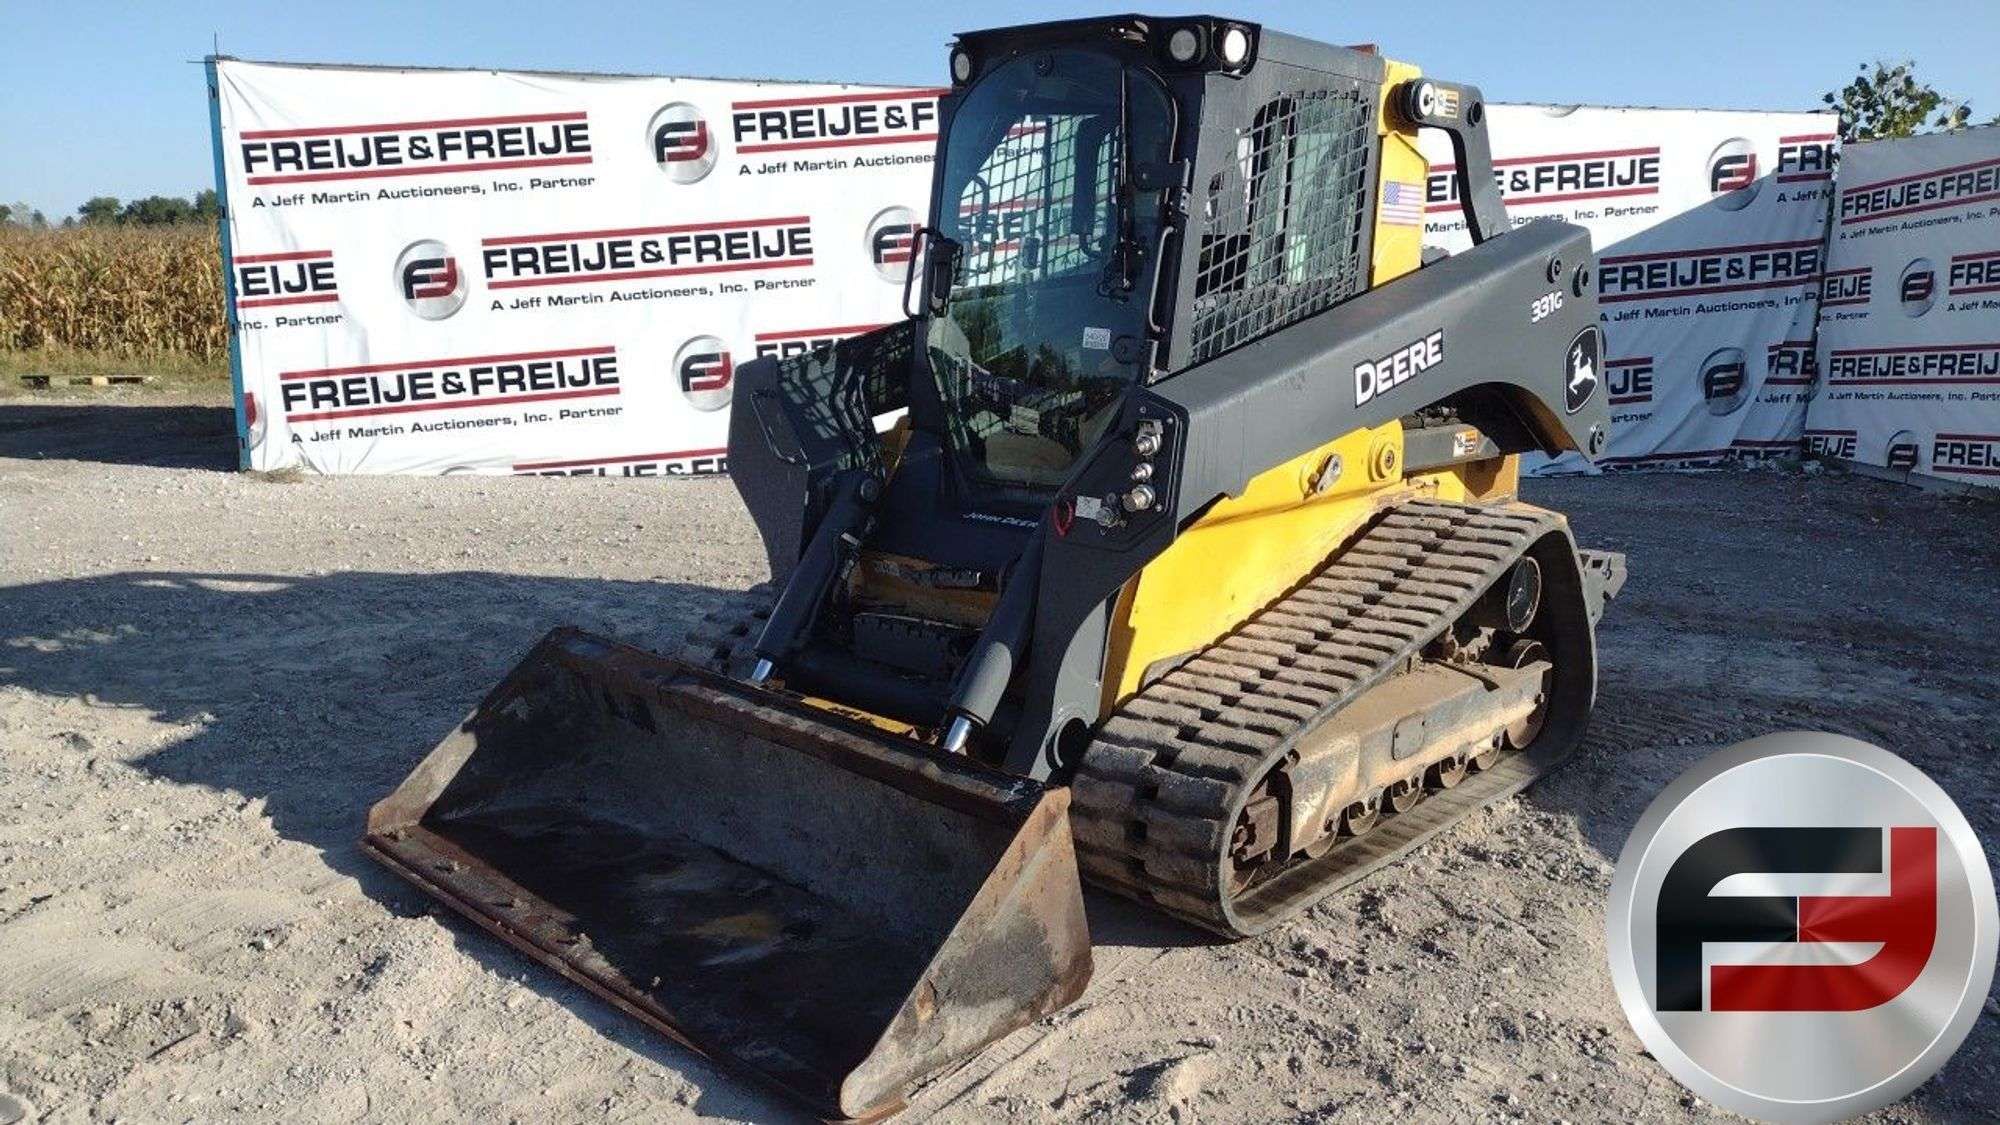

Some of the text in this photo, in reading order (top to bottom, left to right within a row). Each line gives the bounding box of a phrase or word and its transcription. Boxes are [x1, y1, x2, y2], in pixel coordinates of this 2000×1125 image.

[739, 165, 752, 176] A
[757, 162, 787, 175] Jeff
[793, 158, 848, 172] Martin
[252, 175, 596, 208] A Jeff Martin Auctioneers, Inc. Partner
[1574, 208, 1599, 220] Inc.
[1604, 204, 1659, 218] Partner
[490, 277, 817, 311] A Jeff Martin Auctioneers, Inc. Partner
[1531, 291, 1563, 323] 331G
[275, 312, 344, 328] Partner
[1614, 310, 1641, 322] Jeff
[1645, 304, 1691, 319] Martin
[1695, 299, 1780, 315] Auctioneers,
[1354, 328, 1443, 408] DEERE
[289, 406, 624, 444] A Jeff Martin Auctioneers, Inc. Partner
